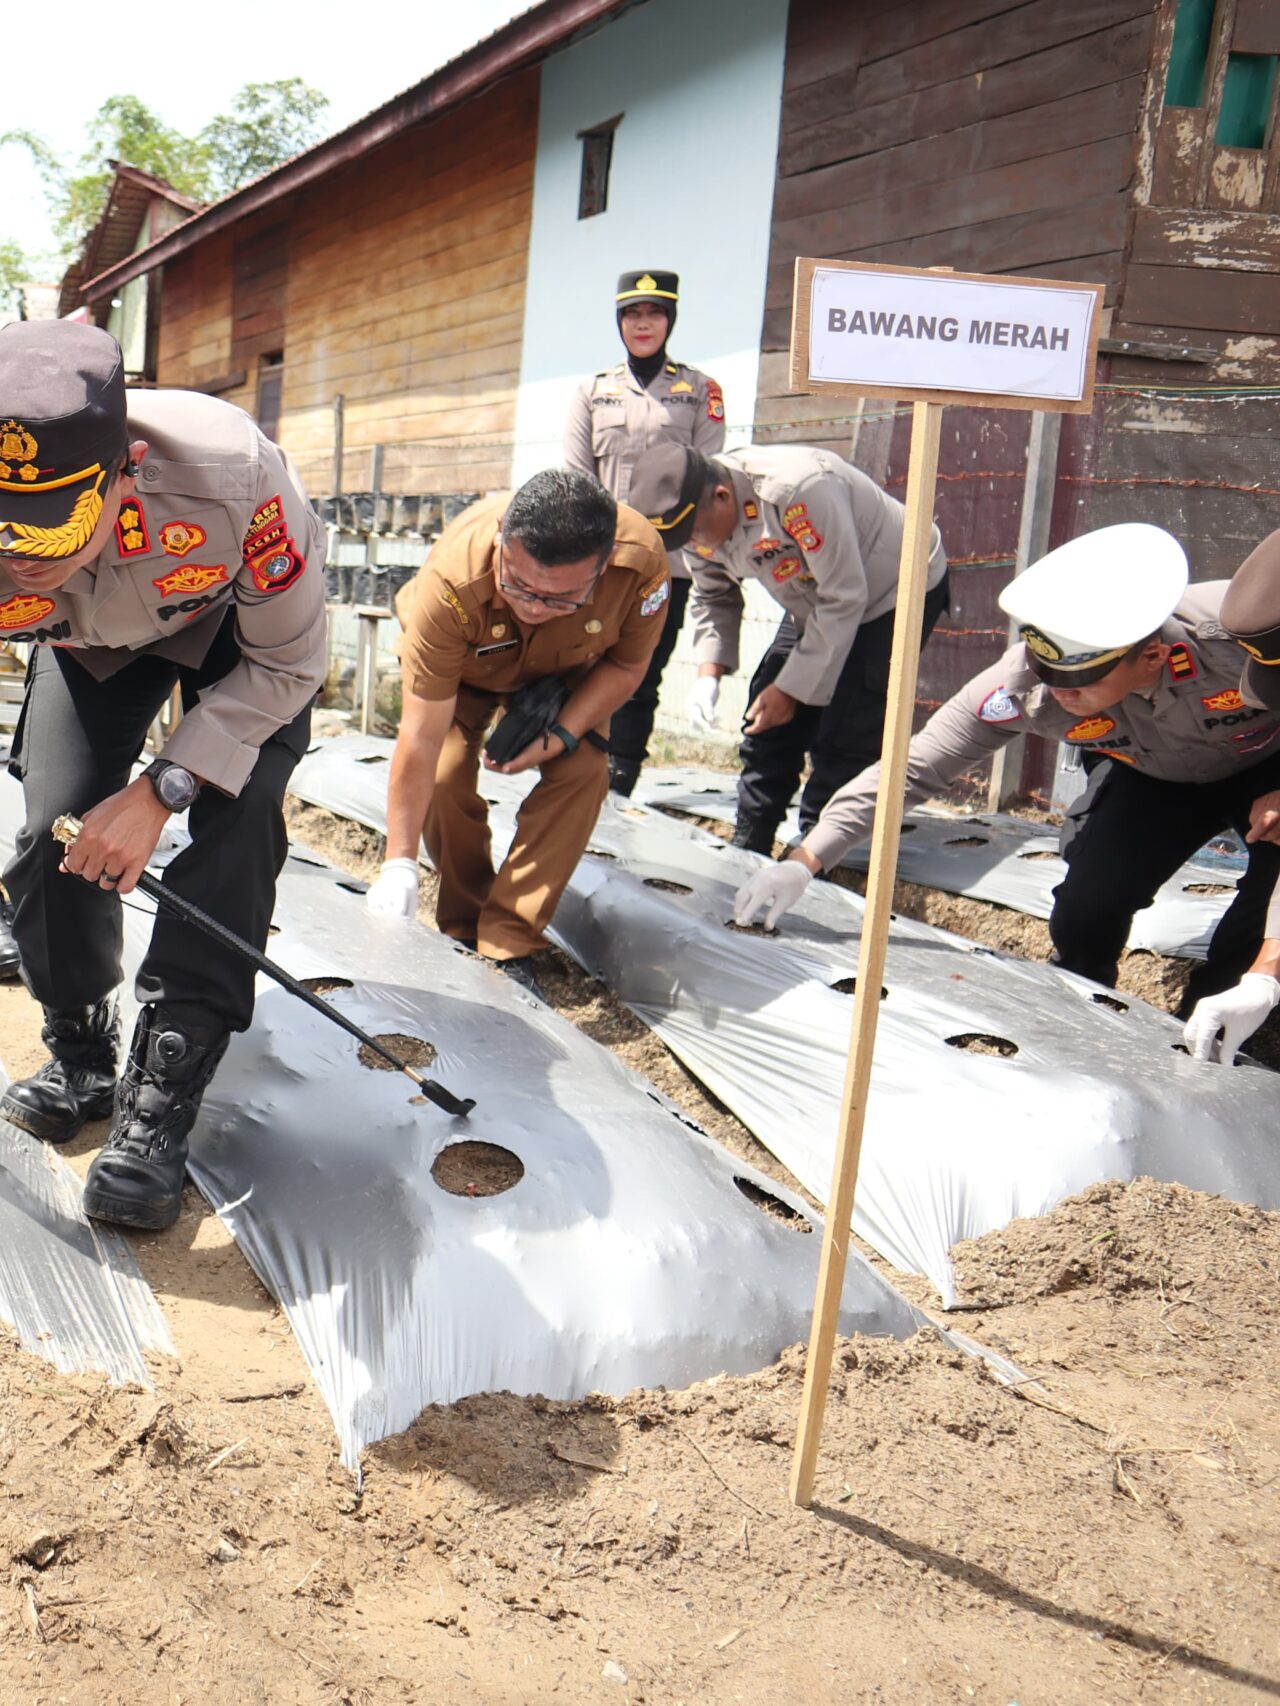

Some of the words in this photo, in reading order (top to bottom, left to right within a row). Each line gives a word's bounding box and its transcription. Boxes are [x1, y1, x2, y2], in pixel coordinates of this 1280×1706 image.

[828, 308, 959, 341] BAWANG
[968, 320, 1069, 351] MERAH
[247, 528, 281, 554] ACEH
